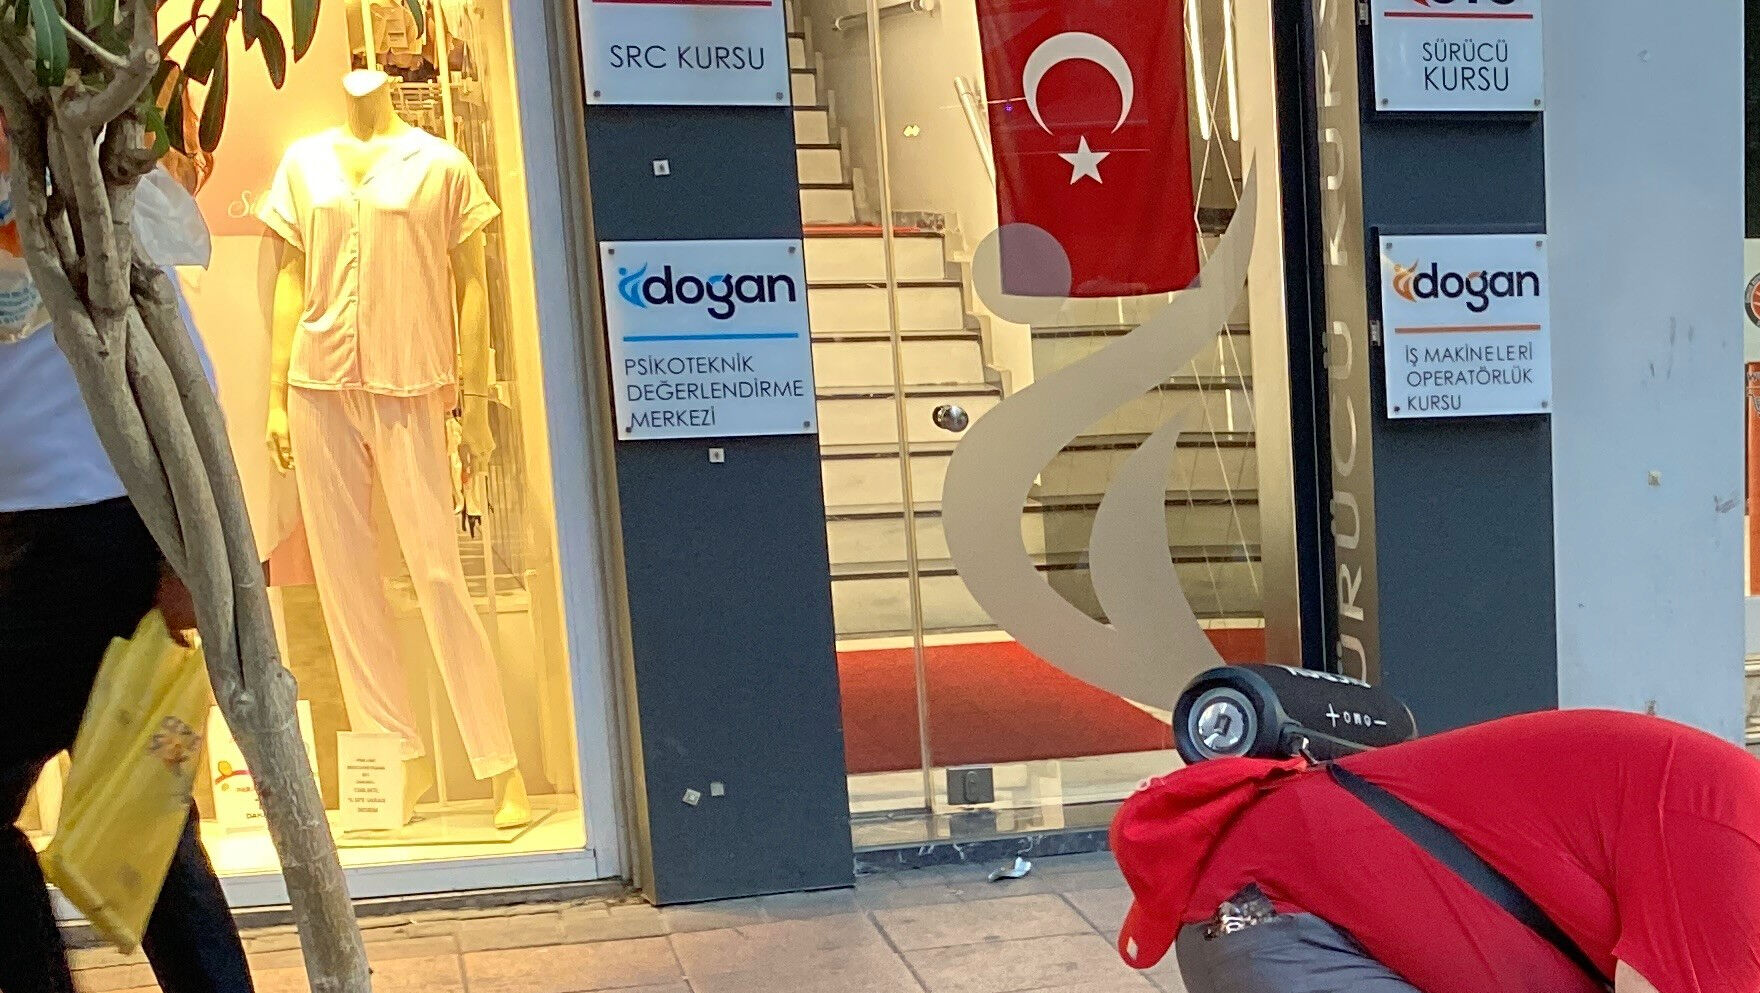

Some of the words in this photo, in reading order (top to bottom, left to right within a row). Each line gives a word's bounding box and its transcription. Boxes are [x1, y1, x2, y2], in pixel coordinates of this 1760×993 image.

[610, 45, 667, 69] SRC
[678, 46, 765, 71] KURSU
[1422, 38, 1509, 64] SÜRÜCÜ
[1424, 66, 1510, 92] KURSU
[624, 352, 755, 376] PSİKOTEKNİK
[1405, 344, 1419, 368] İŞ
[1424, 341, 1534, 364] MAKİNELERİ
[1406, 365, 1533, 388] OPERATÖRLÜK
[626, 378, 805, 402] DEĞERLENDİRME
[1407, 394, 1463, 412] KURSU
[630, 406, 716, 429] MERKEZİ
